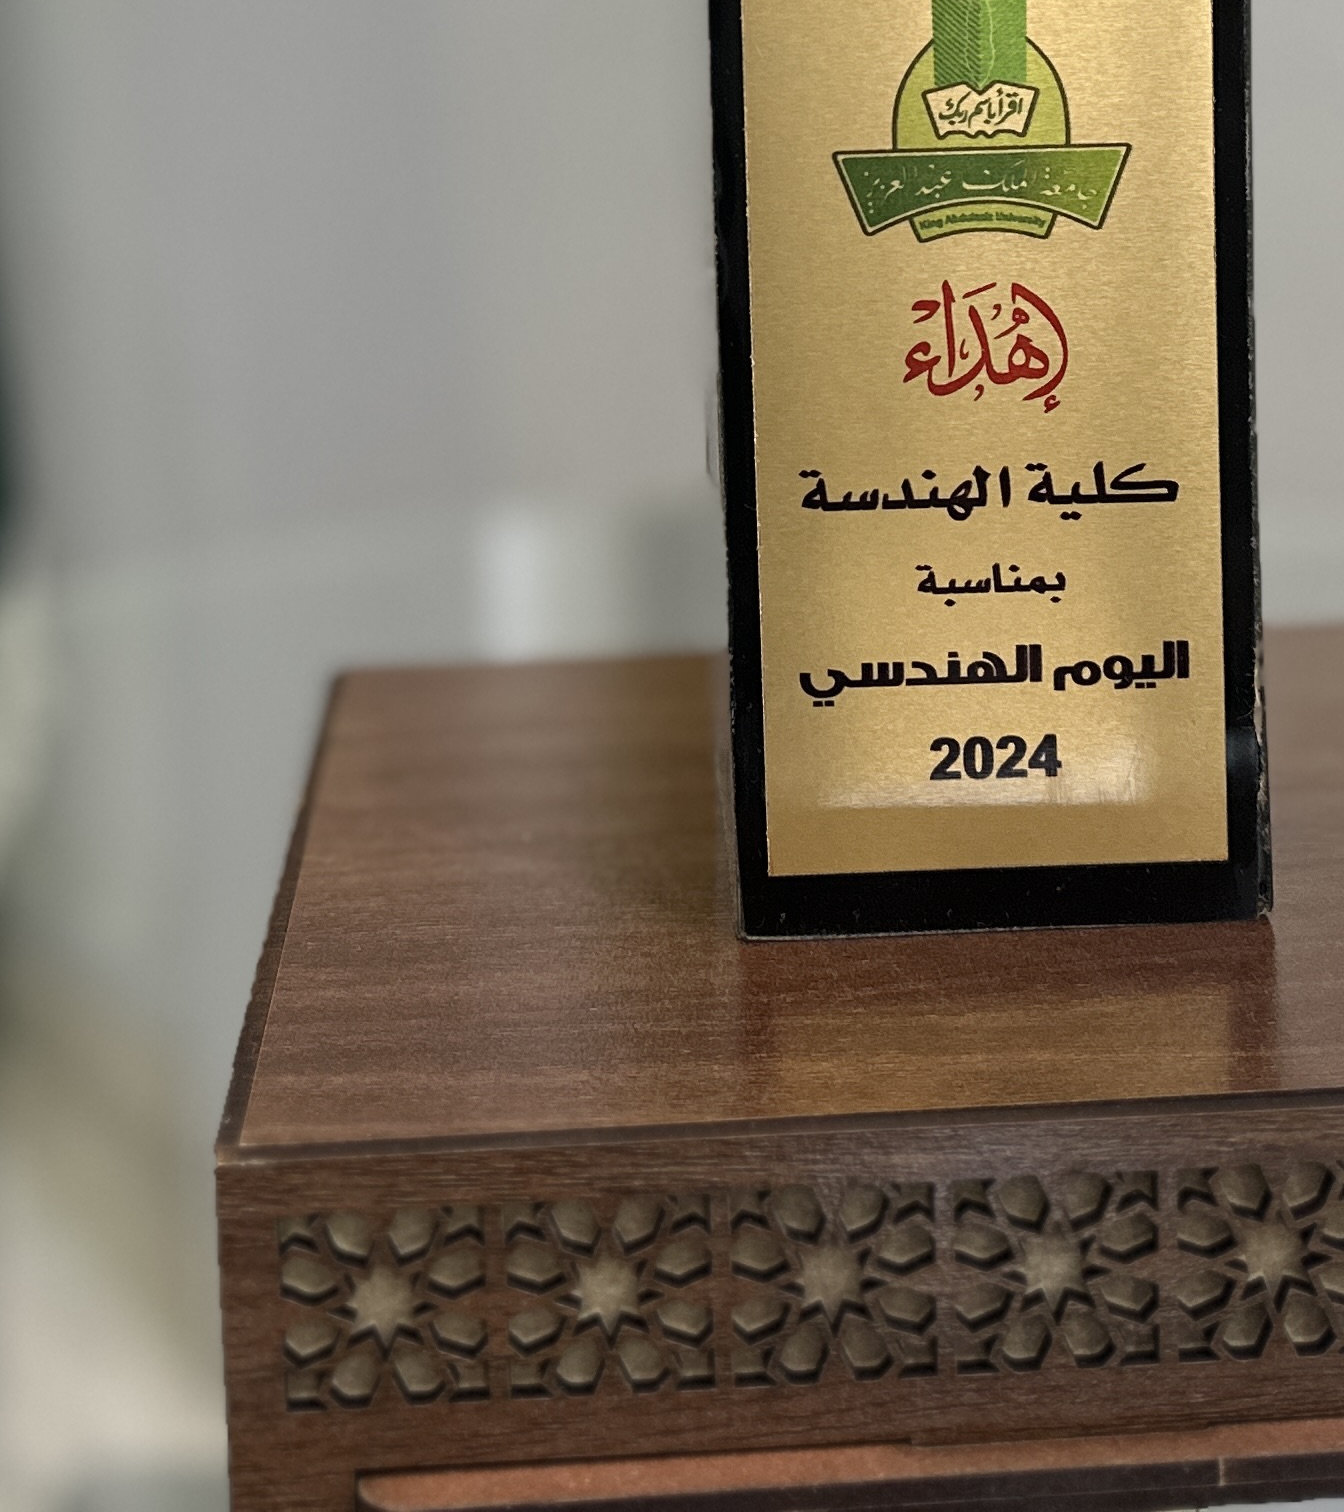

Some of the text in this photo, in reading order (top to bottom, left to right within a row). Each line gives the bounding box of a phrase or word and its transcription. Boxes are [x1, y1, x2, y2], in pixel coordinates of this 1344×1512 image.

[918, 218, 944, 230] King
[798, 460, 1180, 522] كلية الهندسة
[914, 562, 1067, 607] بمناسبة
[798, 639, 1191, 708] اليوم الهندسي
[929, 733, 1062, 781] 2024
